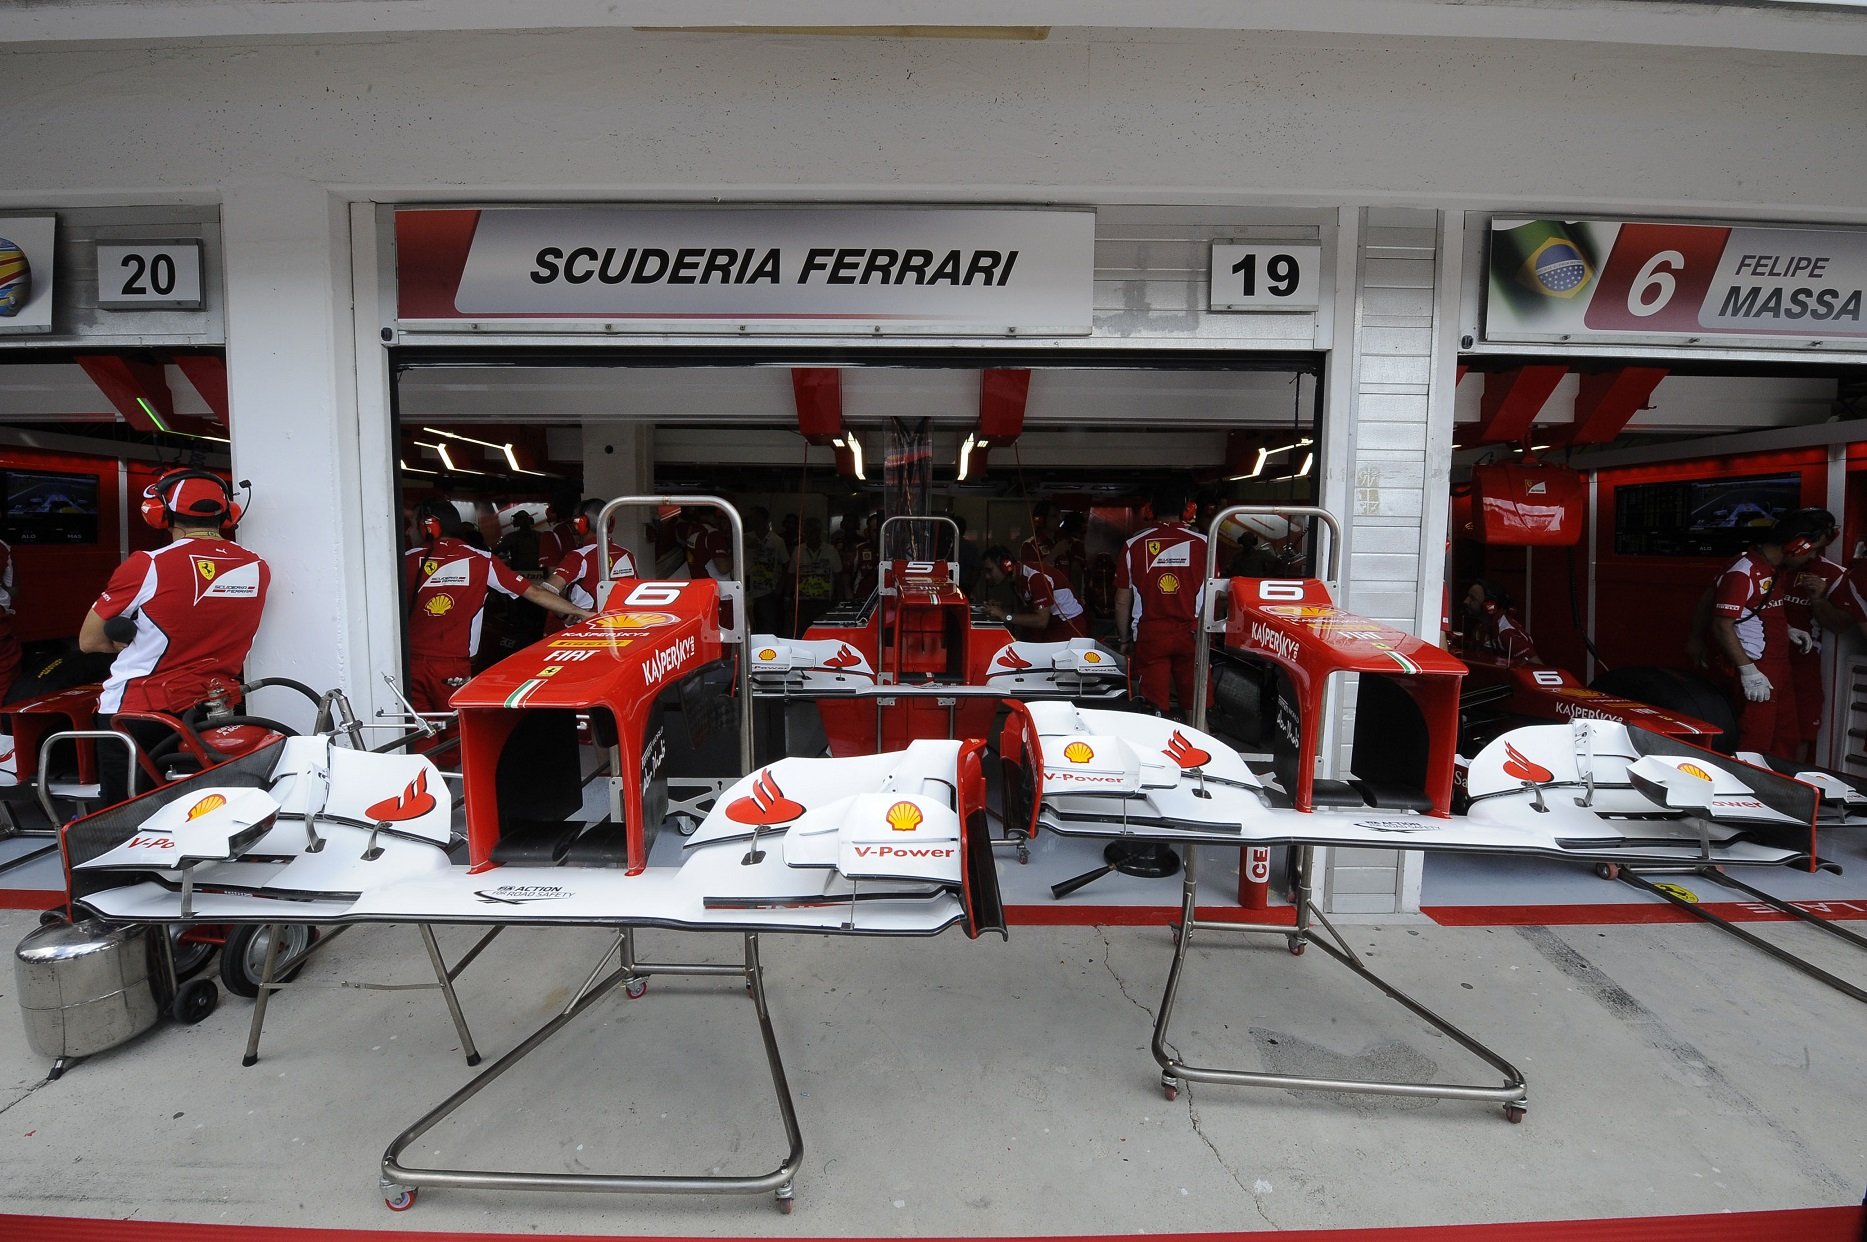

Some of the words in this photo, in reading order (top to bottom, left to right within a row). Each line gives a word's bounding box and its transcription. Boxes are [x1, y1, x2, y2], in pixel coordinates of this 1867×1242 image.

[120, 253, 176, 295] 20
[530, 247, 781, 285] SCUDERIA
[797, 248, 1019, 288] FERRARI
[1231, 253, 1300, 297] 19
[1735, 254, 1831, 279] FELIPE
[1626, 249, 1685, 317] 6
[1718, 285, 1863, 322] MASSA
[904, 561, 936, 574] 5
[623, 582, 690, 606] 6
[1258, 580, 1304, 601] 6
[1251, 621, 1294, 661] KASPERSKY
[544, 650, 601, 662] FIAT
[642, 638, 690, 686] KASPERSKY
[1531, 670, 1564, 686] 6
[1044, 772, 1124, 784] V-Power
[854, 846, 955, 858] V-Power
